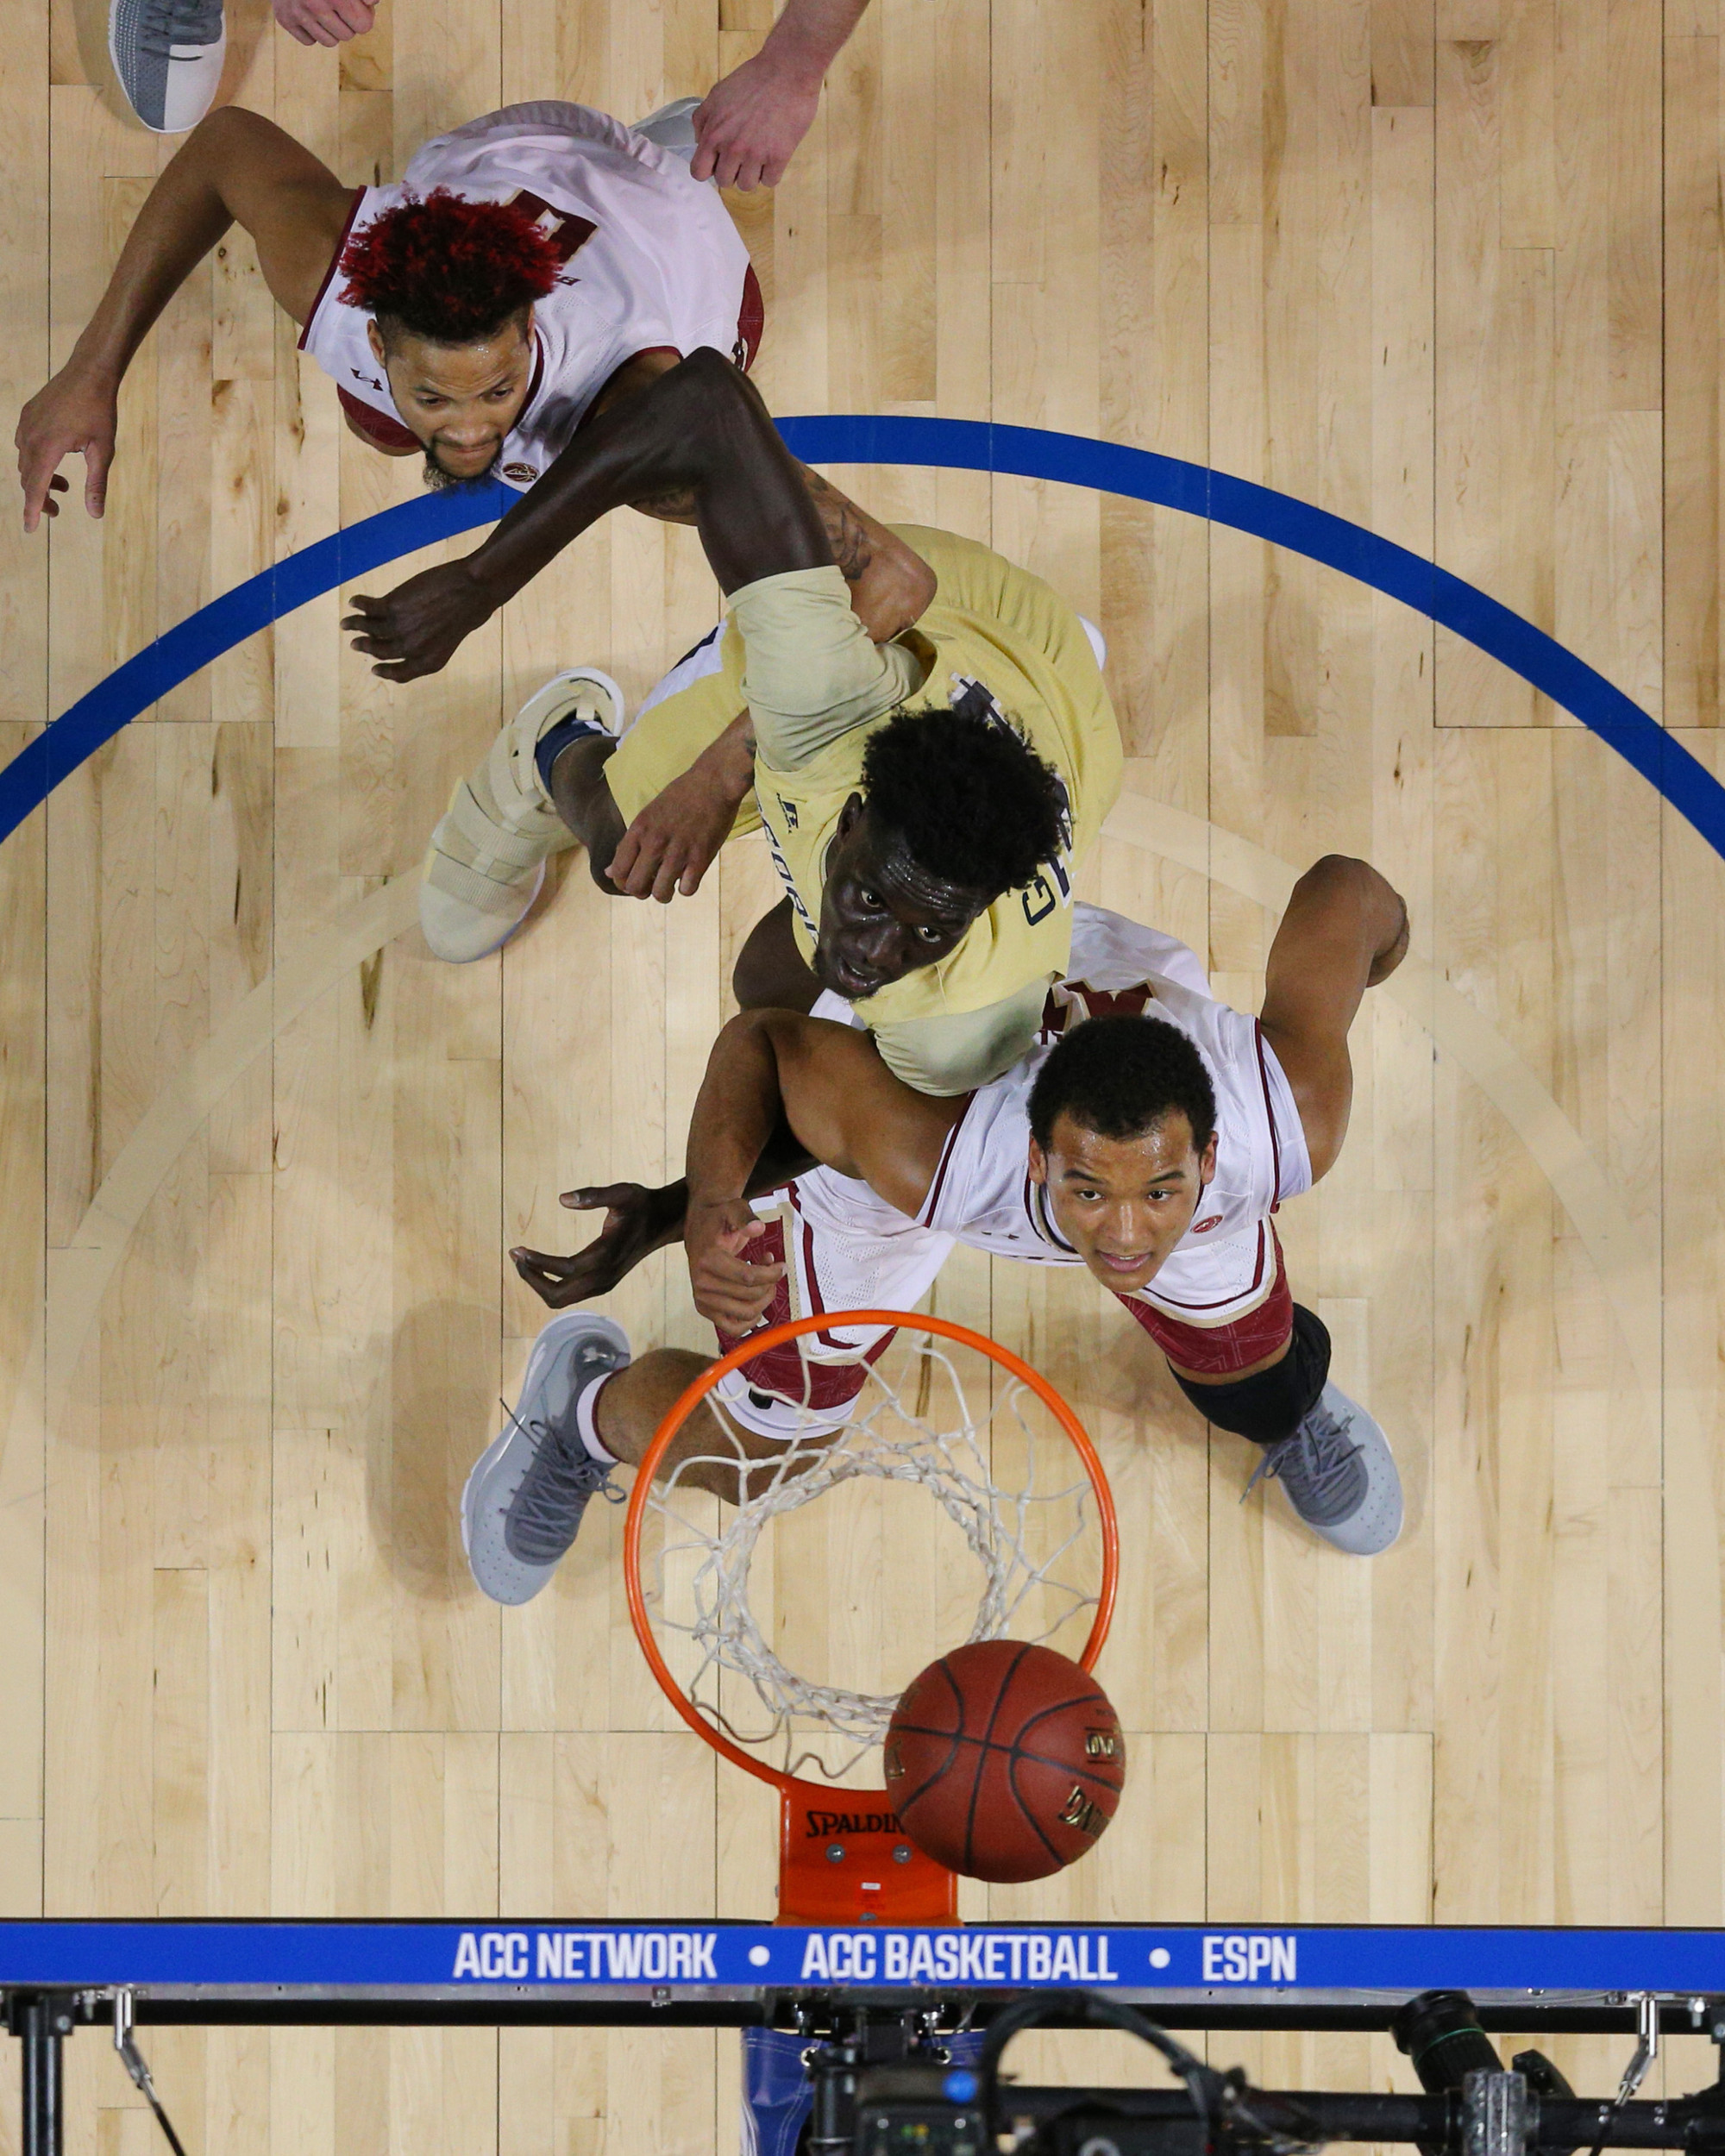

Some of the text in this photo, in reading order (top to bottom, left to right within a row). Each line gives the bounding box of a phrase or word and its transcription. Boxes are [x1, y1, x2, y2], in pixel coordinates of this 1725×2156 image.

[806, 1810, 906, 1838] SPALDIN
[453, 1933, 718, 1980] ACC NETWORK
[801, 1934, 1119, 1983] ACC BASKETBALL
[1202, 1936, 1297, 1983] ESPN
